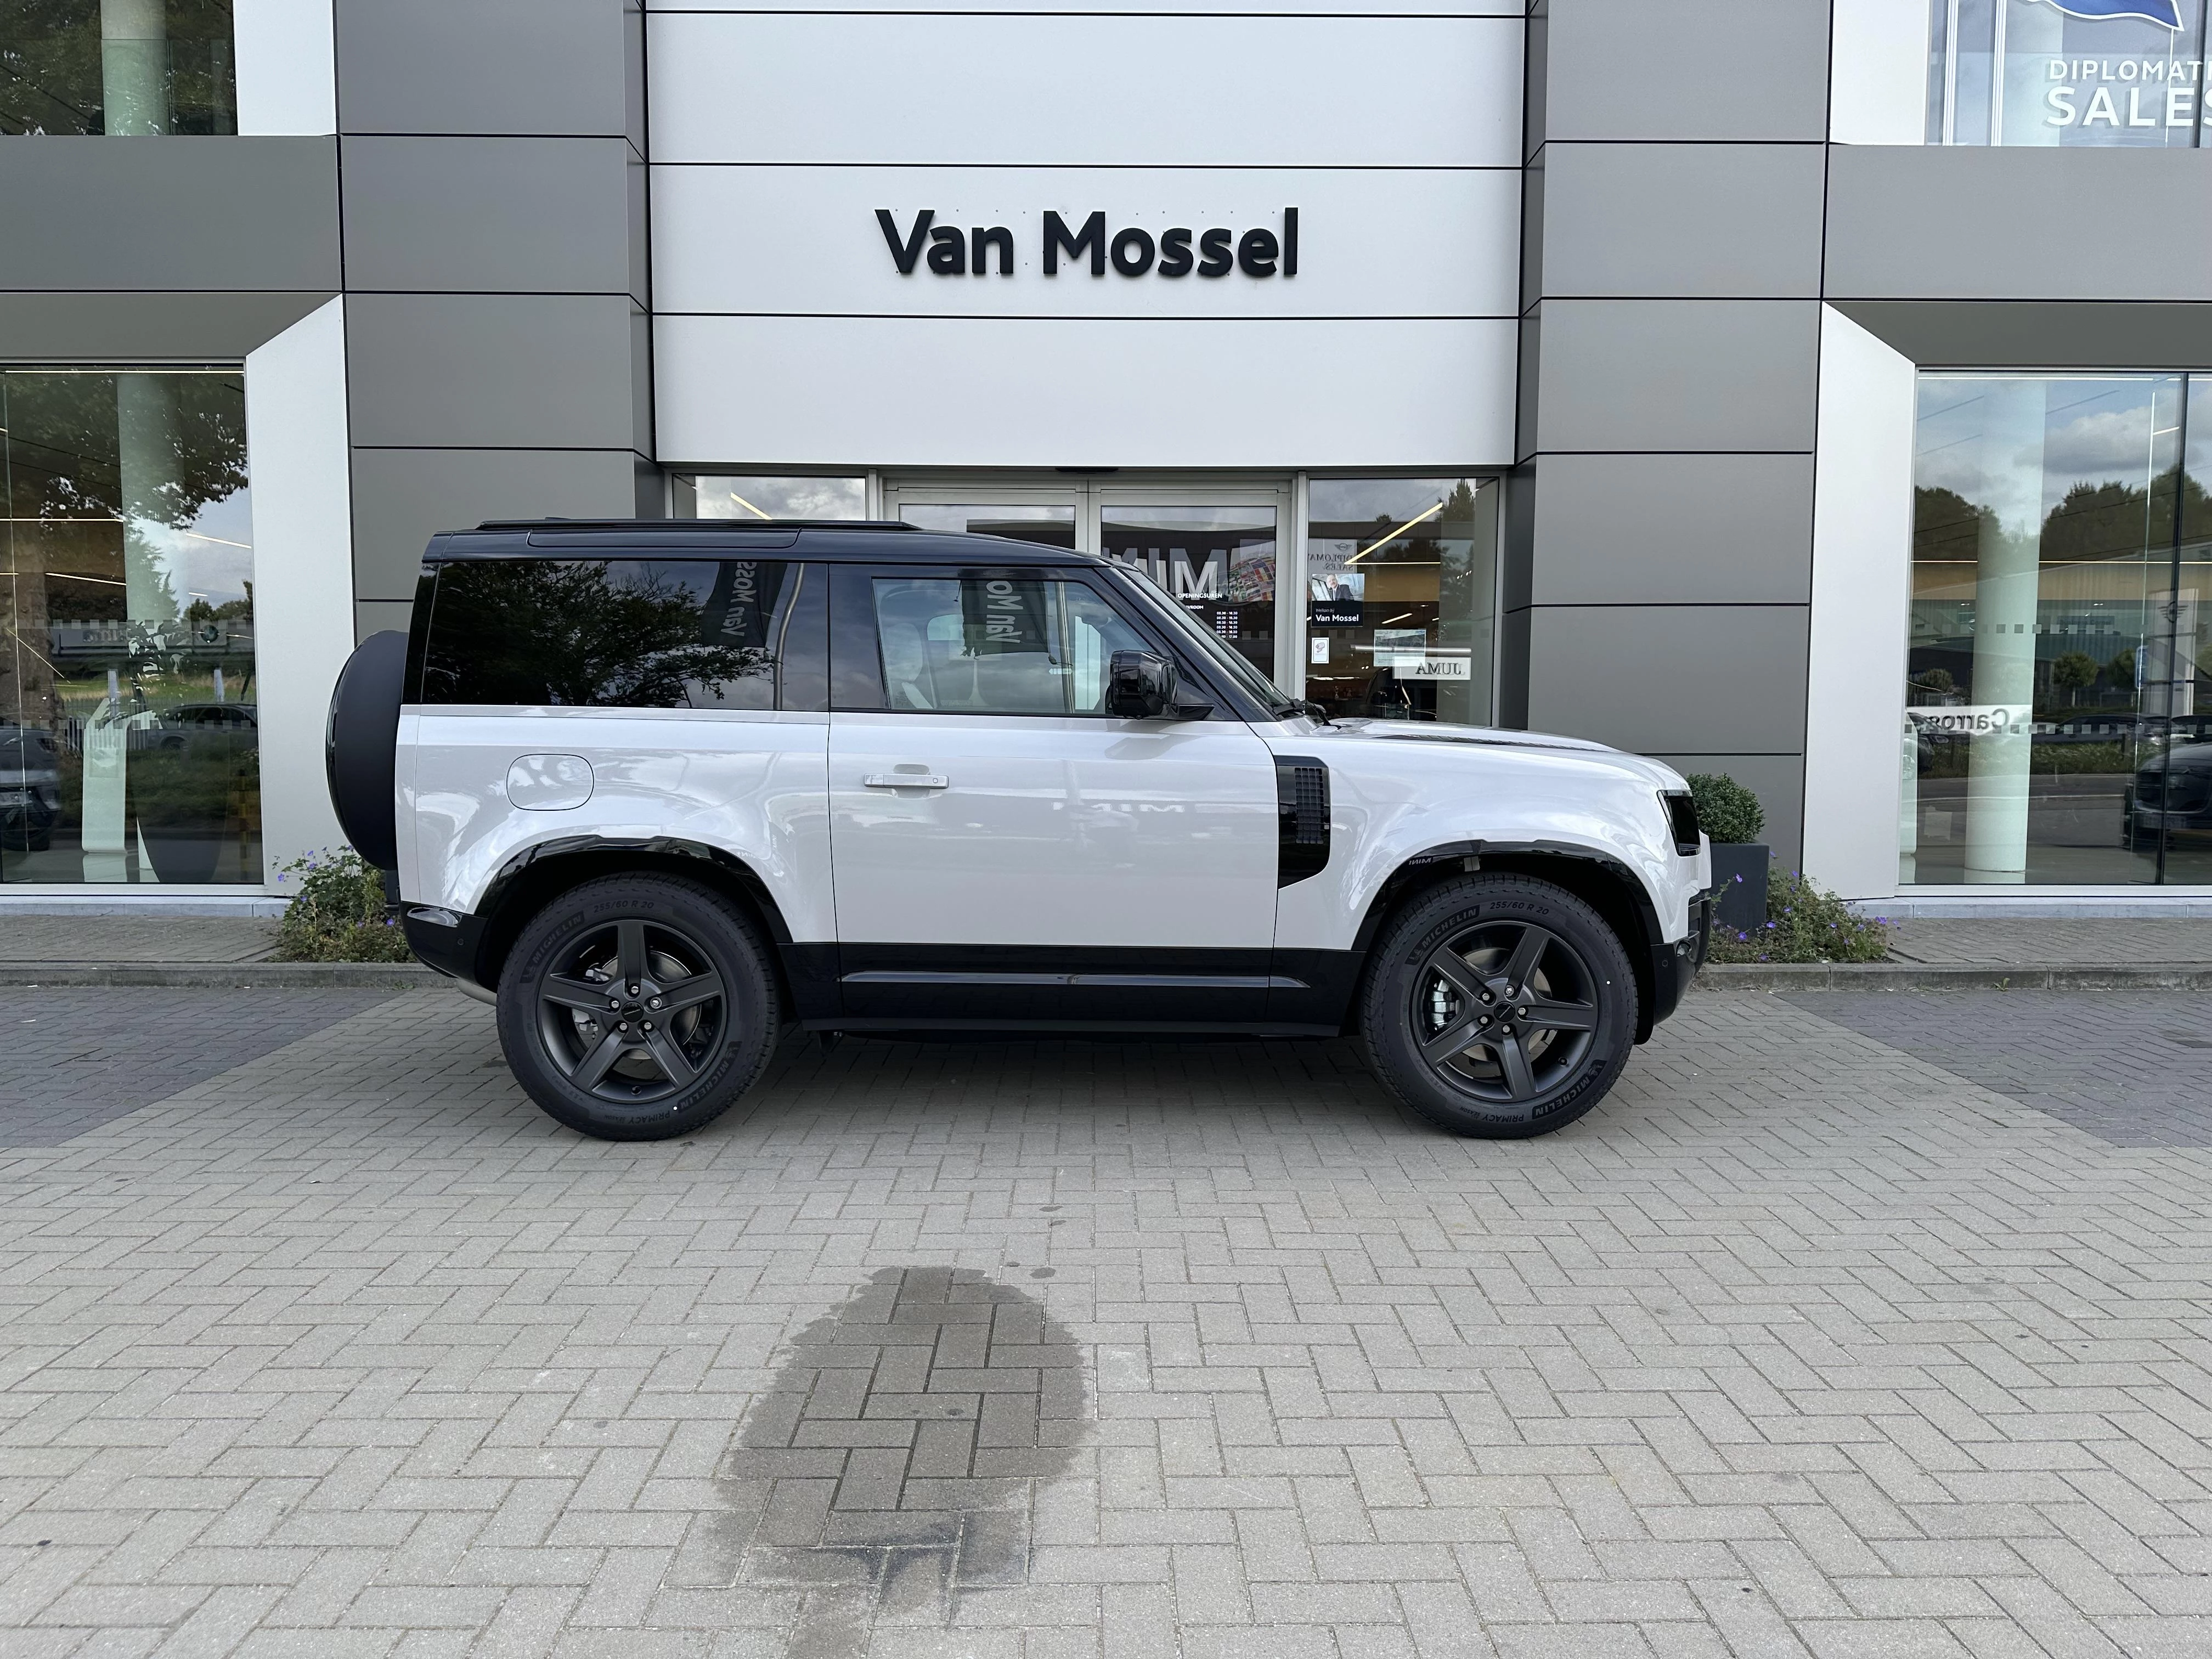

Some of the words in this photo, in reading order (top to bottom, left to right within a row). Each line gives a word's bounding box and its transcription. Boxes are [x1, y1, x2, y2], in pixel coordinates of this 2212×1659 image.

[874, 209, 1014, 275] Van
[1043, 207, 1299, 277] Mossel
[1332, 614, 1359, 622] Mossel
[594, 900, 628, 913] 255/60
[1490, 901, 1524, 910] 255/60
[1536, 907, 1550, 915] 20
[532, 914, 582, 964] MICHELIN
[1421, 908, 1477, 949] MICHELIN
[680, 1060, 729, 1110] MICHELIN
[1535, 1076, 1590, 1116] MICHELIN
[627, 1110, 670, 1124] PRIMACY
[1481, 1114, 1524, 1123] PRIMACY
